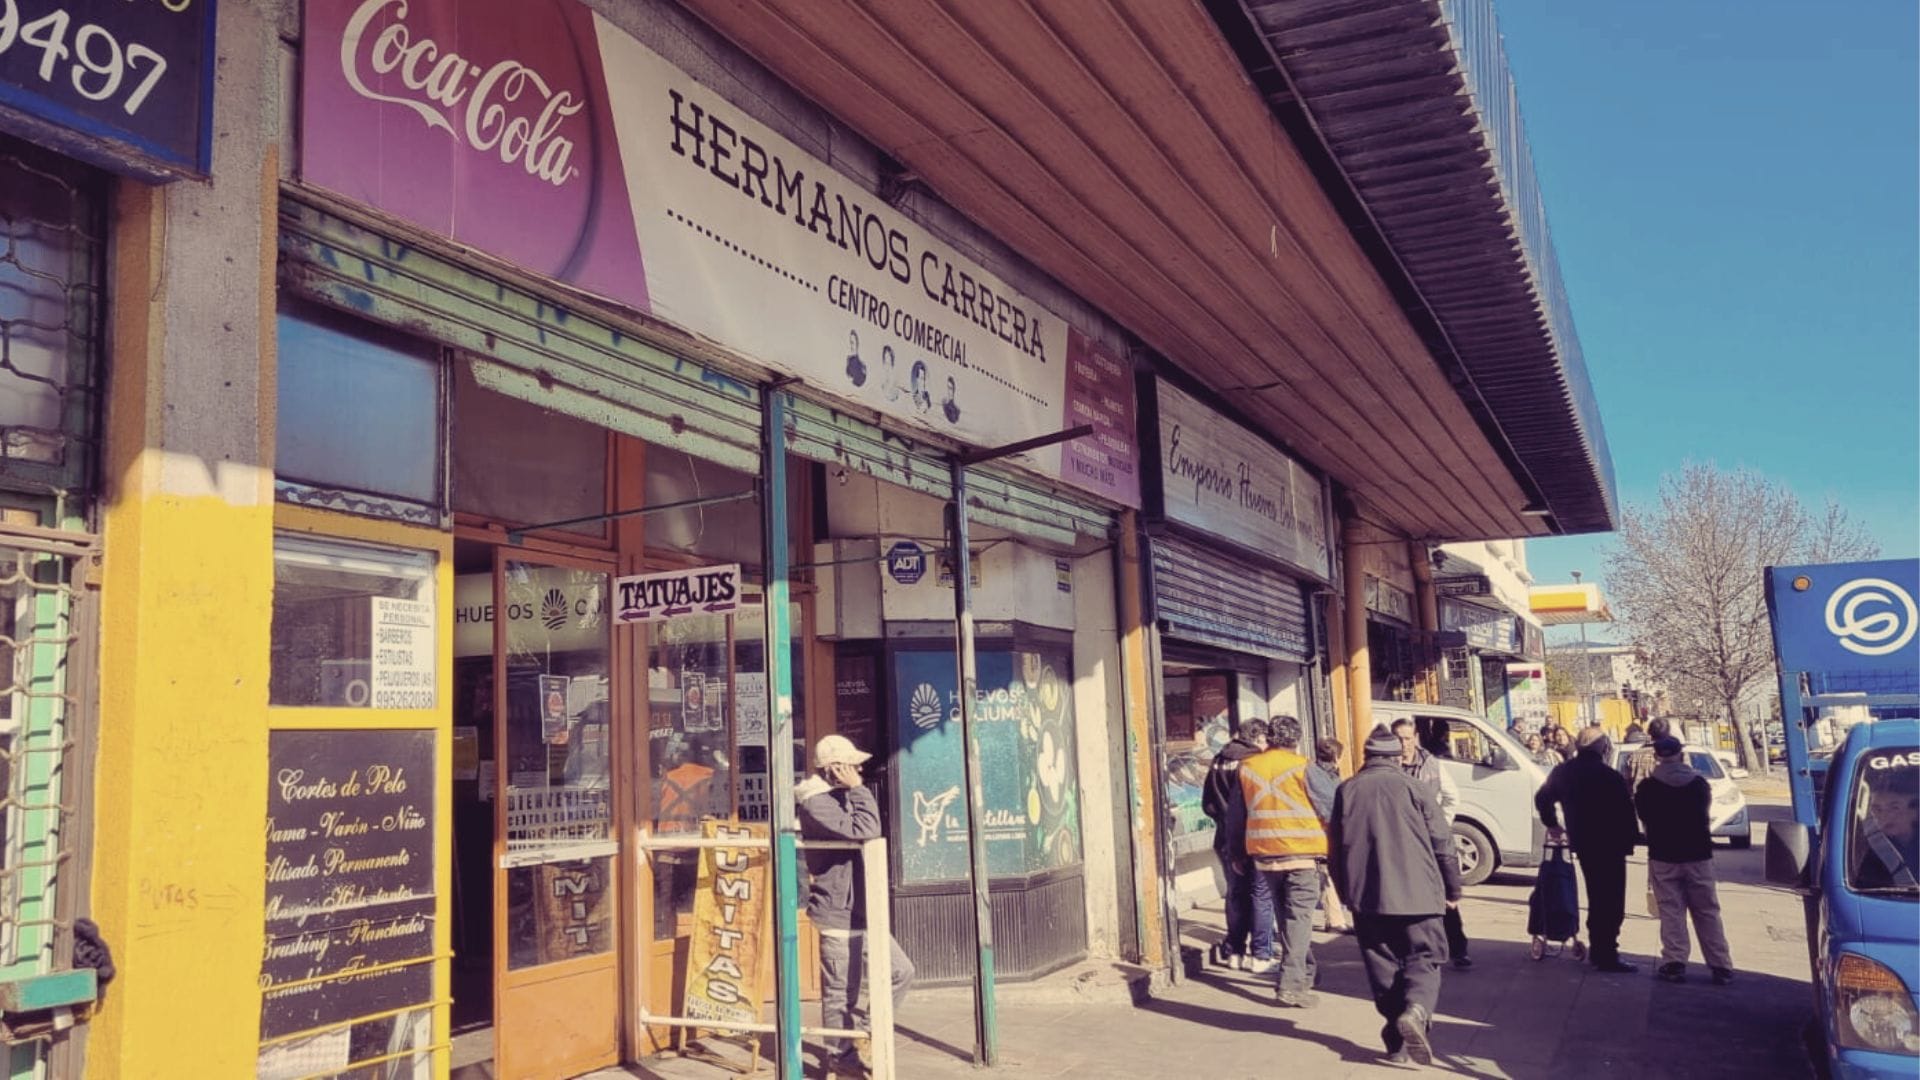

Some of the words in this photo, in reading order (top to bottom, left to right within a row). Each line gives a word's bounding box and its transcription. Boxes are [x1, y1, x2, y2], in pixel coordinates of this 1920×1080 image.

[668, 89, 911, 284] HERMANOS
[920, 250, 1047, 363] CARRERA
[827, 274, 889, 330] CENTRO
[893, 309, 969, 368] COMERCIAL
[1169, 424, 1233, 511] Emporio
[894, 555, 920, 571] ADT
[619, 572, 736, 611] TATUAJES
[383, 612, 426, 625] PERSONAL
[456, 602, 534, 624] HUEOS
[949, 688, 1019, 706] HEVOS
[277, 768, 337, 804] Cortes
[340, 770, 360, 797] de
[365, 764, 407, 796] Pelo
[320, 811, 368, 838] Varón
[381, 805, 426, 832] Niño
[323, 847, 410, 877] Permanente
[346, 912, 426, 946] Planchados
[706, 824, 751, 1004] HUMITAS
